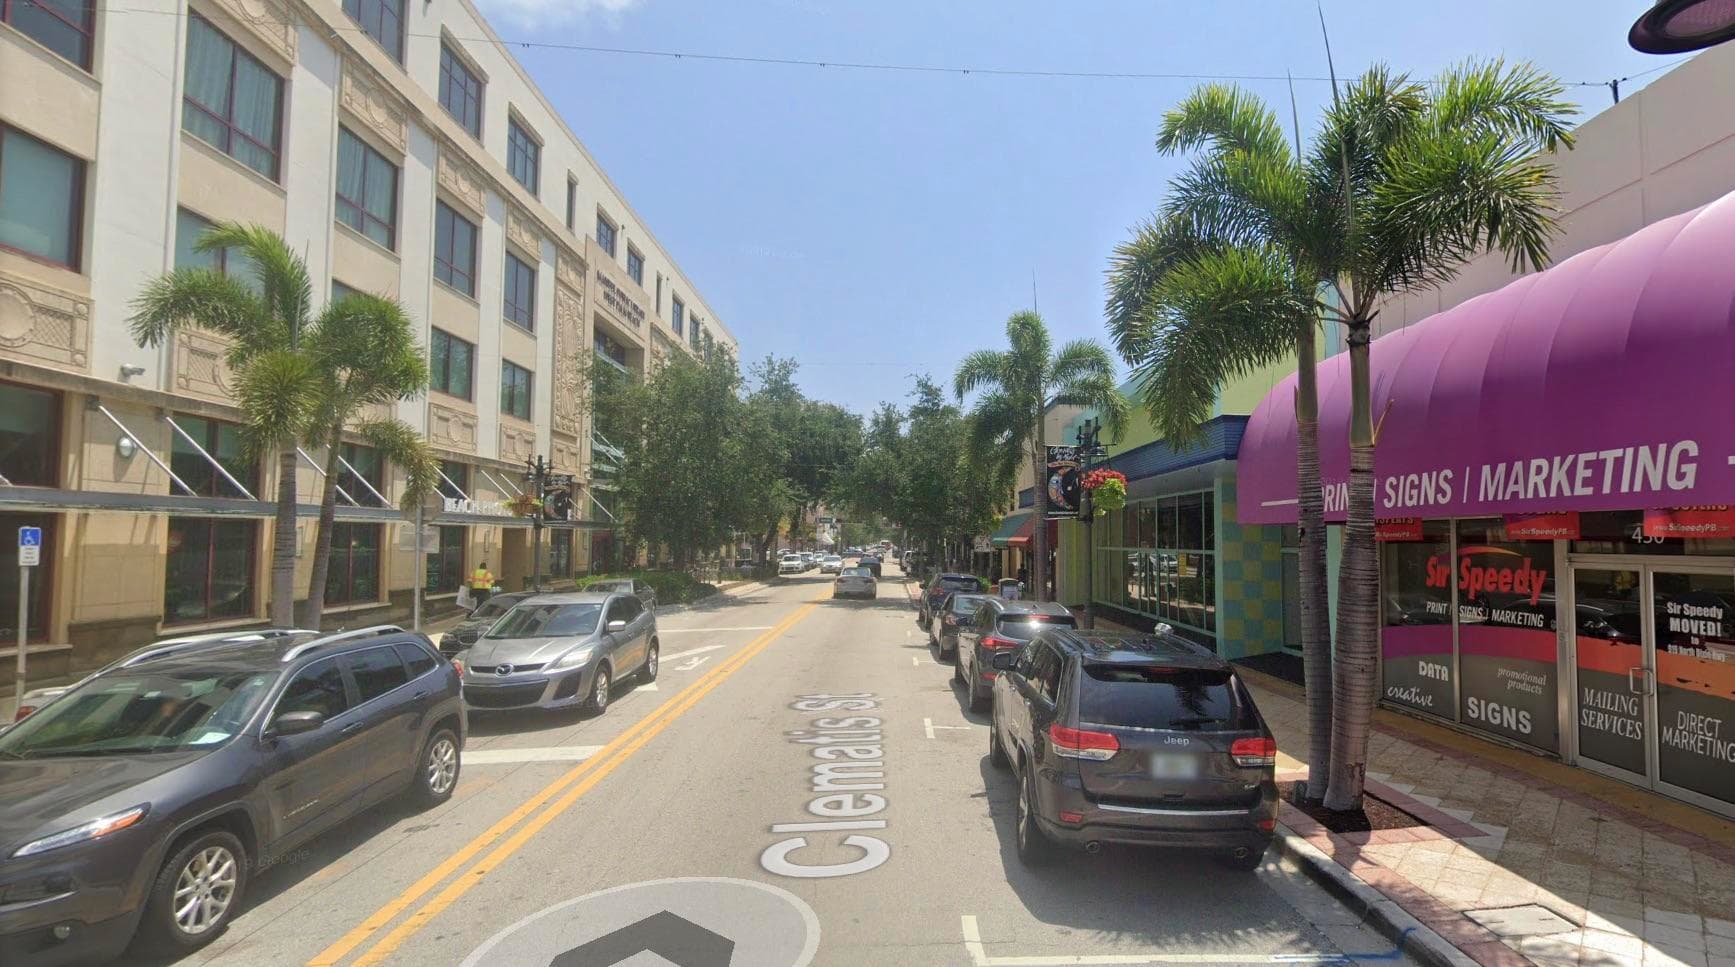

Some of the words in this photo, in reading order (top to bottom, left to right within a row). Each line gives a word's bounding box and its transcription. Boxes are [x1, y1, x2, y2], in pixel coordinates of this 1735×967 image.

[1322, 482, 1349, 512] RIN
[1383, 469, 1453, 508] SIGNS
[1478, 439, 1699, 502] MARKETING
[1426, 555, 1451, 588] Sir
[1459, 556, 1547, 606] Speedy
[1426, 601, 1447, 616] PRINT
[1459, 605, 1484, 620] SIGNS
[1491, 609, 1544, 628] MARKETING
[1667, 601, 1681, 614] Sir
[1683, 603, 1723, 620] Speedy
[1669, 617, 1721, 637] MOVED!
[1418, 660, 1449, 682] DATA
[1497, 667, 1547, 685] promotional
[1387, 685, 1433, 707] creative
[1507, 679, 1543, 695] products
[1583, 687, 1639, 716] MAILING
[1467, 696, 1532, 735] SIGNS
[1580, 709, 1643, 740] SERVICES
[1677, 711, 1722, 738] DIRECT
[1163, 735, 1190, 746] Jeep
[1662, 726, 1735, 763] MARKETING
